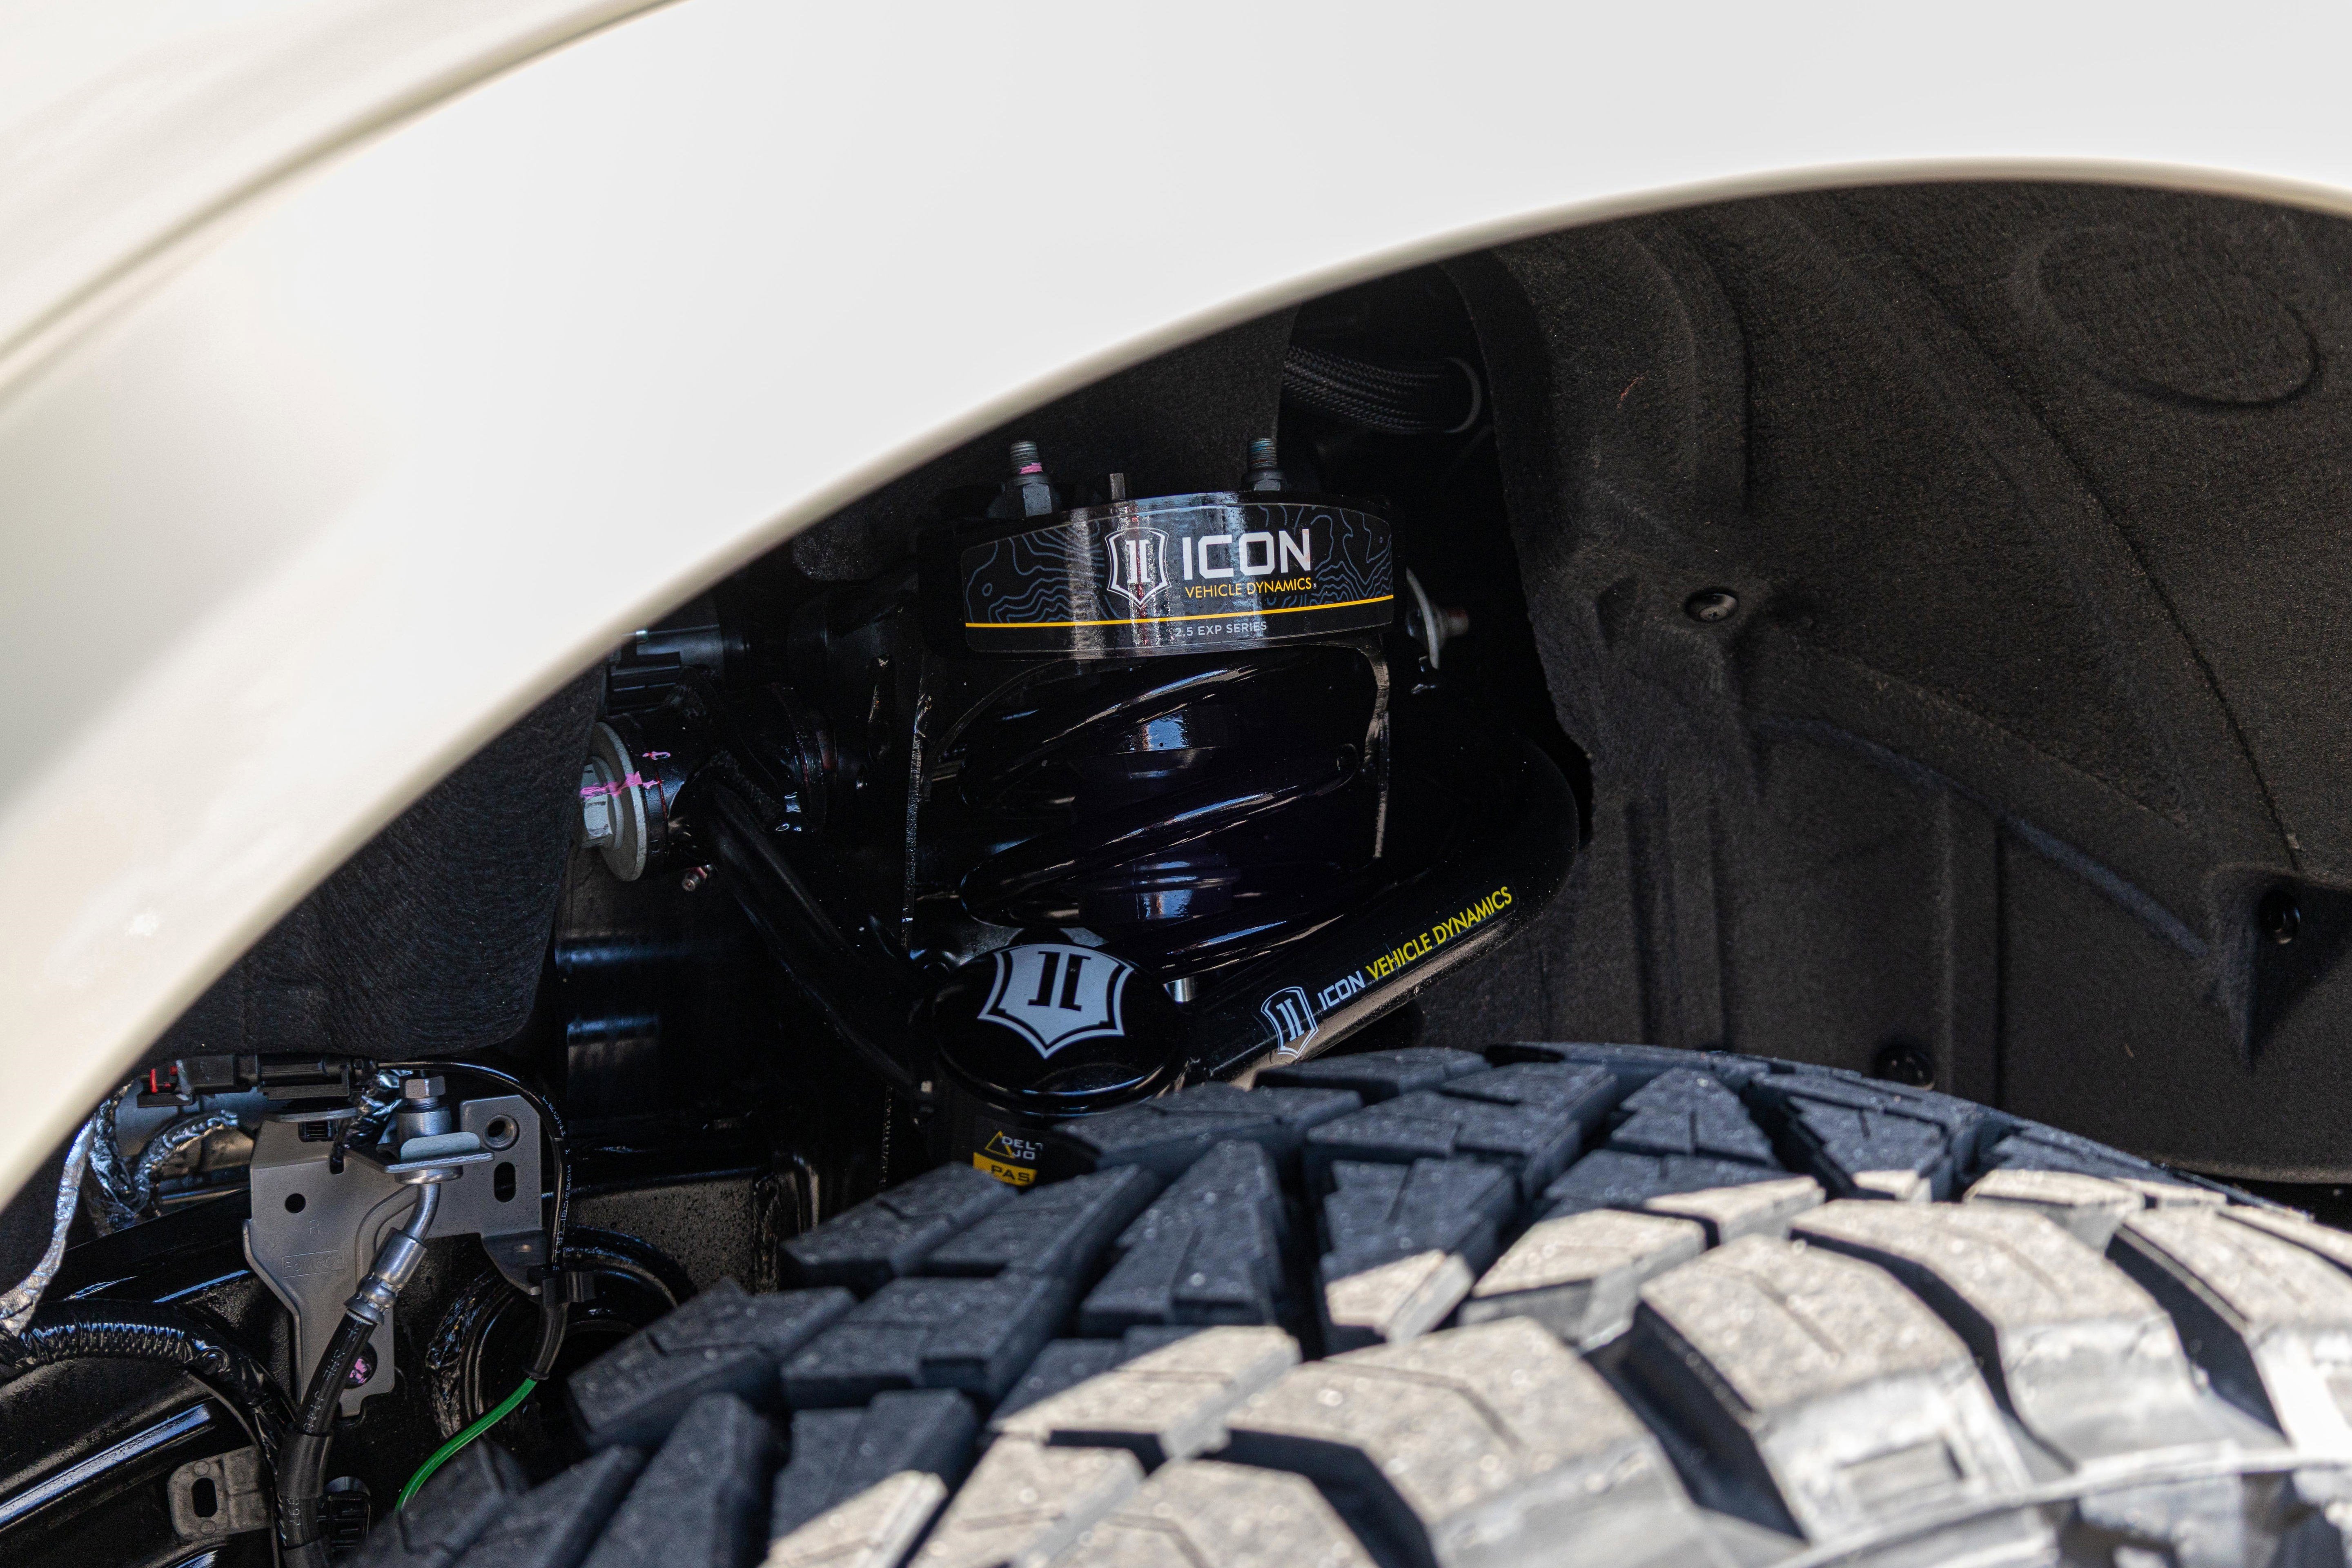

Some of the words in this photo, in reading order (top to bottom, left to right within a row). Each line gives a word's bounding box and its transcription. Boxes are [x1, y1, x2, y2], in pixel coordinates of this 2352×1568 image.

[1182, 528, 1311, 580] ICON
[1185, 582, 1243, 599] VEHICLE
[1174, 627, 1195, 639] 2.5
[1198, 625, 1223, 637] EXP
[1225, 621, 1267, 636] SERIES
[1317, 971, 1366, 1010] ICON
[1365, 933, 1432, 980] VEHICLE
[1432, 886, 1512, 945] DYNAMICS
[990, 1164, 1030, 1183] PAS
